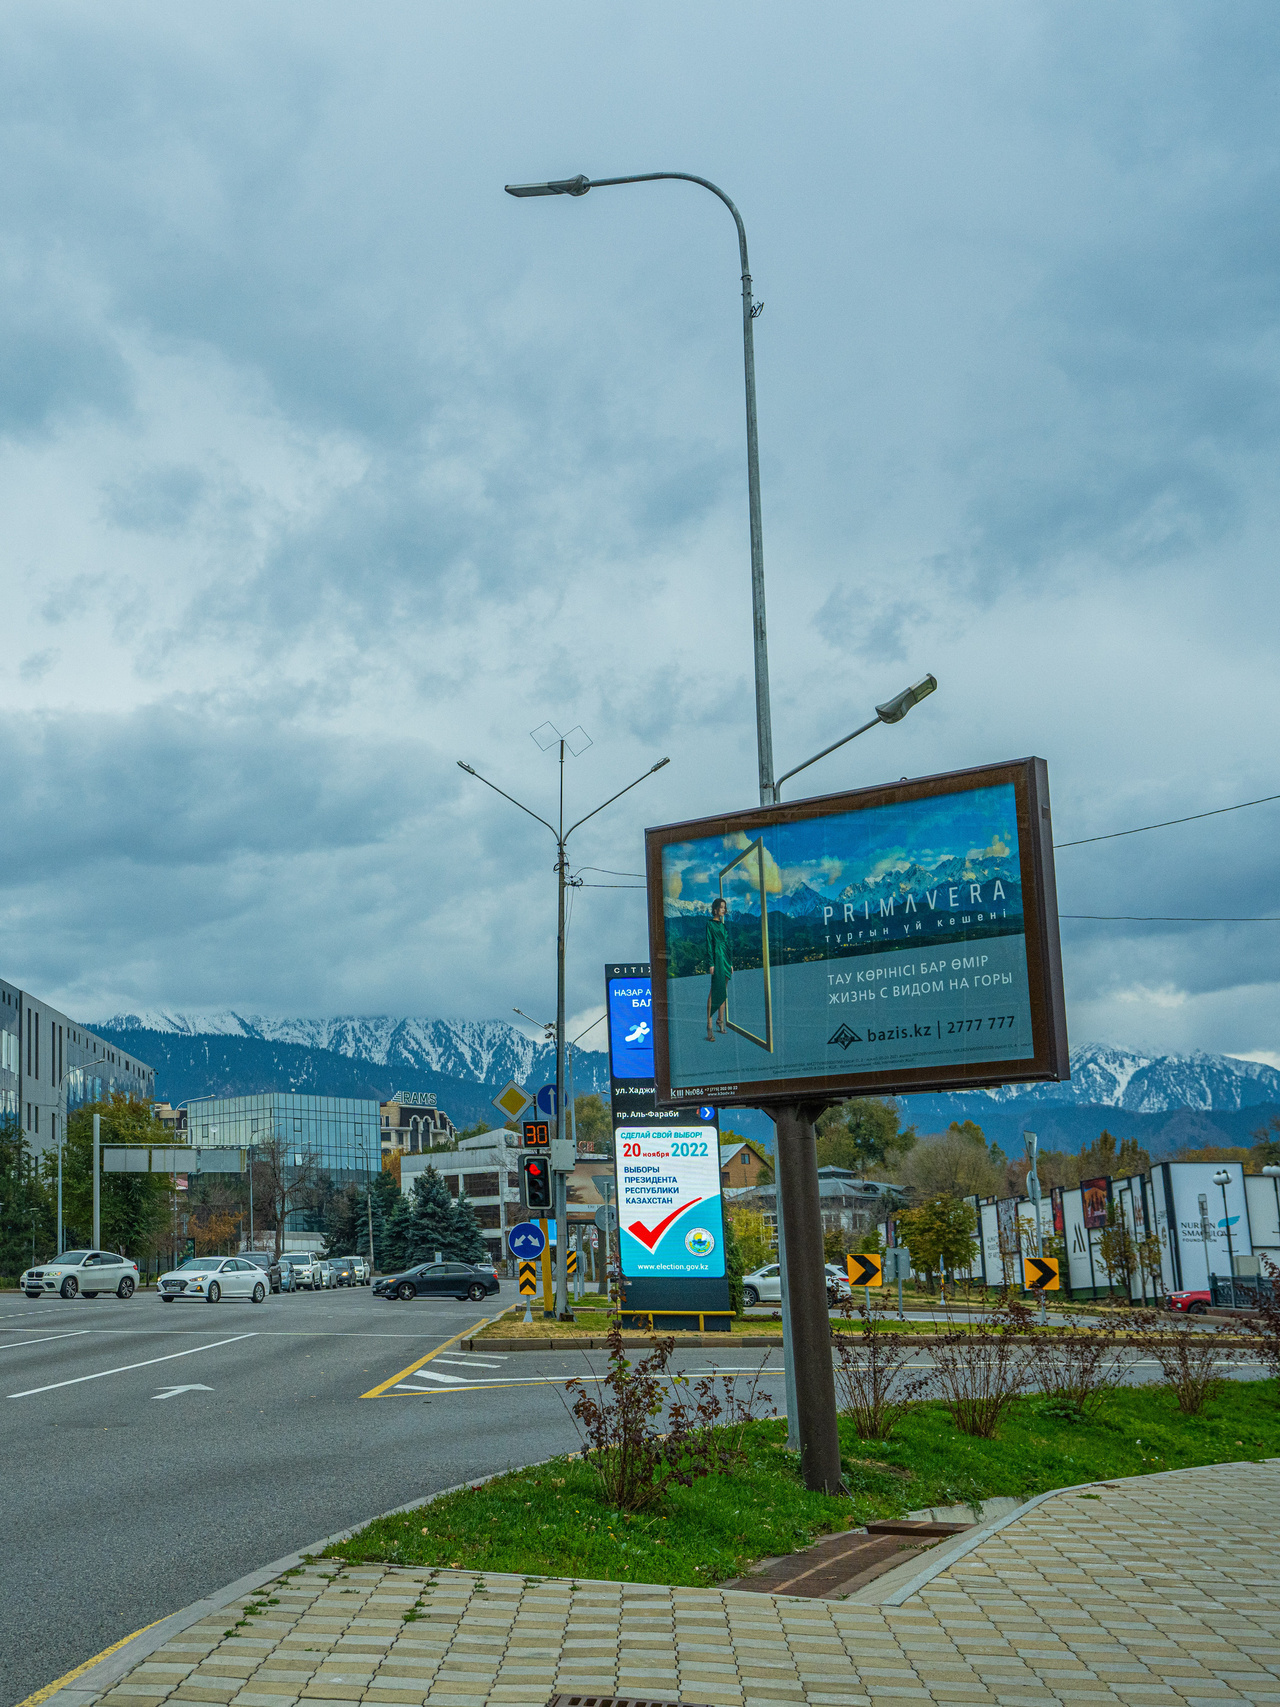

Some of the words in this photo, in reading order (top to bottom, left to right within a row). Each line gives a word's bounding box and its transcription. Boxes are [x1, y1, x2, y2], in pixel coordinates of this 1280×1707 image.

[824, 880, 1006, 925] PRIMAVERA
[937, 909, 1006, 927] кешені
[827, 973, 852, 986] ТАУ
[857, 964, 915, 983] КӨРІНІСІ
[920, 960, 947, 974] БАР
[951, 955, 989, 970] ӨМІР
[614, 988, 643, 997] НАЗАР
[829, 989, 876, 1005] ЖИЗНЬ
[880, 987, 888, 998] С
[893, 980, 944, 997] ВИДОМ
[949, 978, 969, 990] НА
[974, 972, 1012, 988] ГОРЫ
[867, 1023, 932, 1042] bazis.kz
[947, 1018, 982, 1034] 2777
[988, 1015, 1015, 1030] 777
[402, 1091, 437, 1105] RAMS
[615, 1087, 627, 1095] ул.
[616, 1111, 629, 1119] пр.
[630, 1110, 679, 1119] Аль-Фараби
[526, 1125, 548, 1144] 30
[620, 1131, 650, 1139] СДЕЛАЙ
[652, 1130, 672, 1139] СВОЙ
[674, 1131, 702, 1139] ВЫБОР!
[623, 1143, 641, 1157] 20
[671, 1142, 708, 1157] 2022
[624, 1176, 677, 1184] ПРЕЗИДЕНТА
[637, 1263, 709, 1271] www.election.gov.kz
